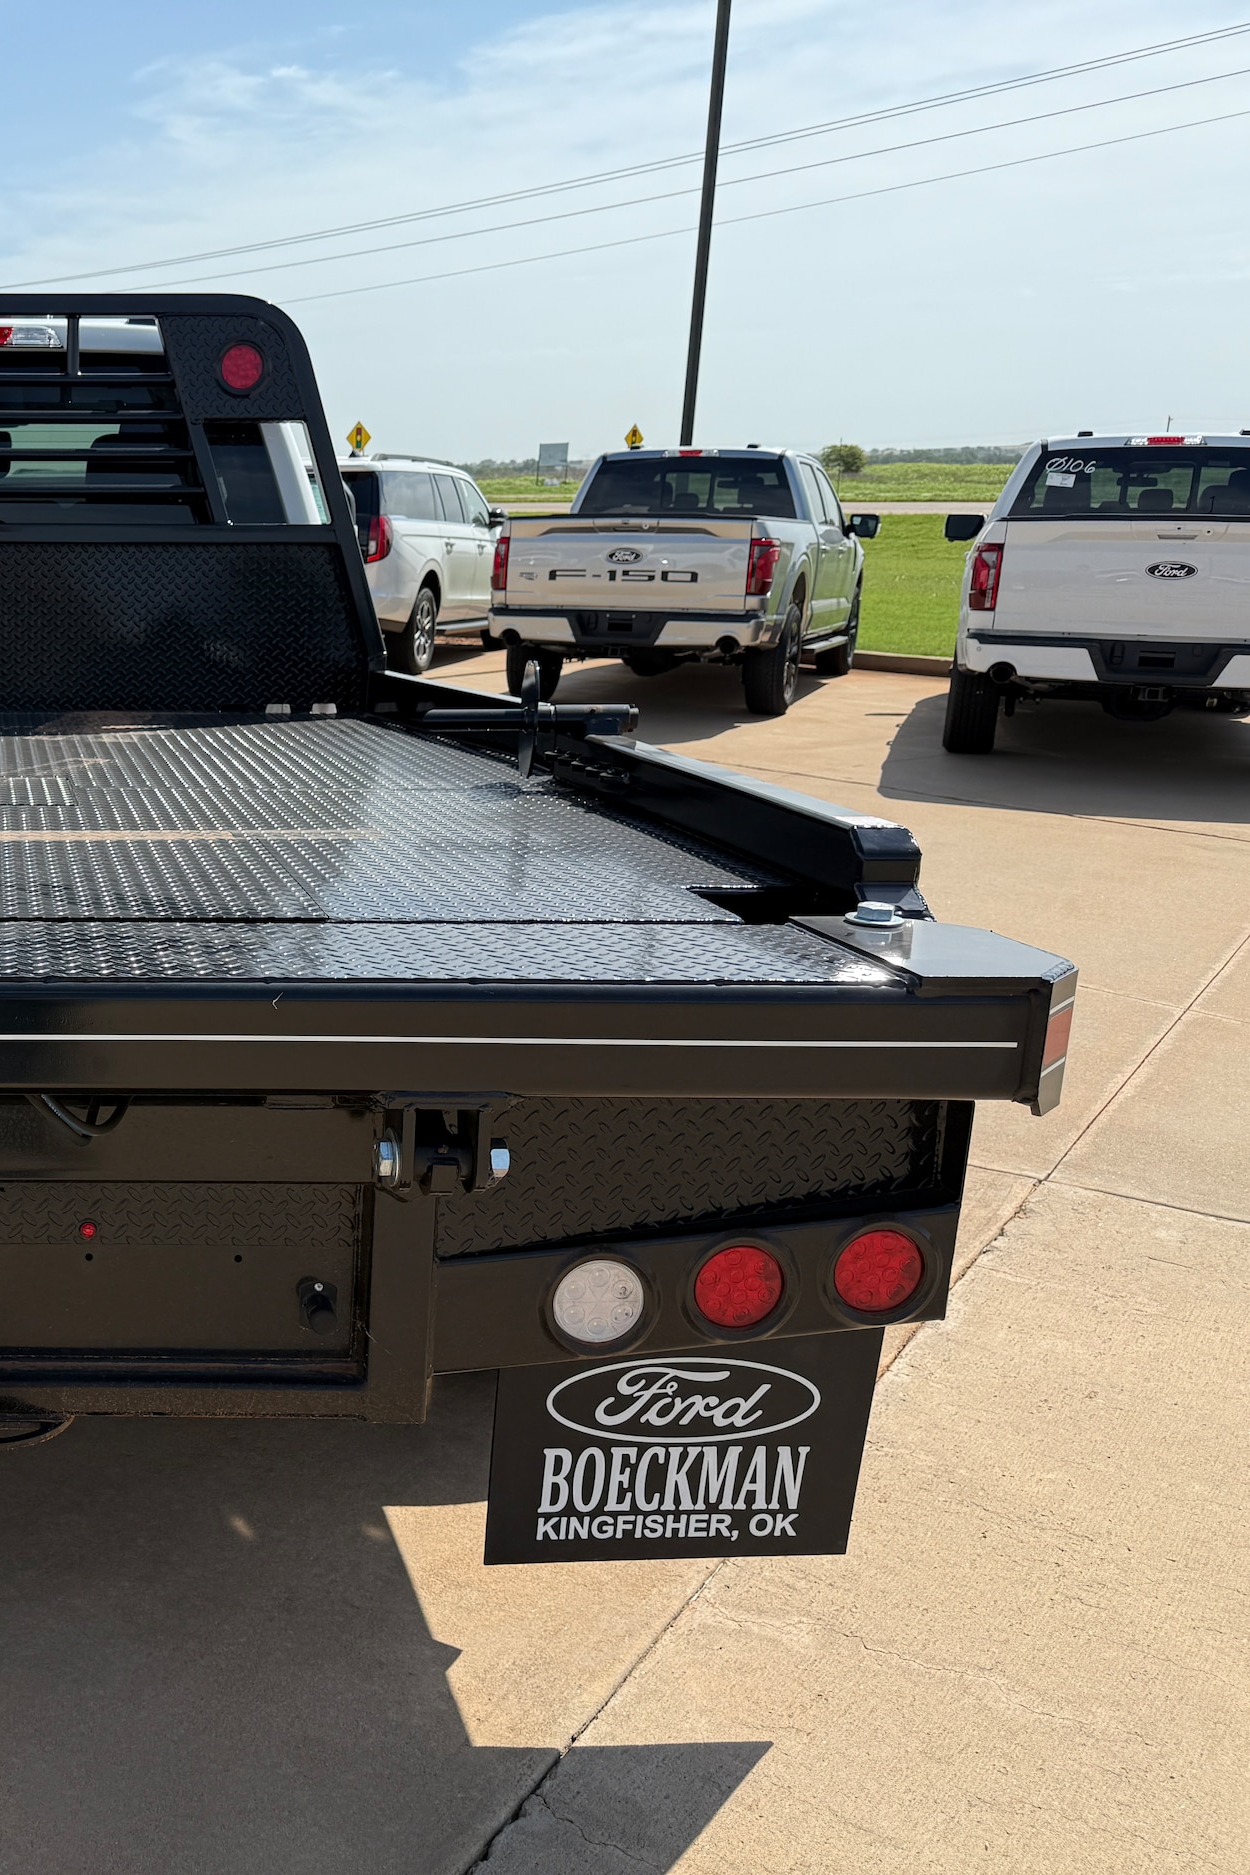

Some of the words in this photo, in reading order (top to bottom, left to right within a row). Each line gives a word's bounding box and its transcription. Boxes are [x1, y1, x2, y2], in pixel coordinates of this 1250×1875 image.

[611, 550, 637, 562] Ford
[548, 569, 699, 583] F-150
[1154, 564, 1189, 577] Ford
[595, 1366, 772, 1428] Ford
[537, 1446, 811, 1513] BOECKMAN
[535, 1514, 739, 1542] KINGFISHER,
[749, 1513, 799, 1538] OK
